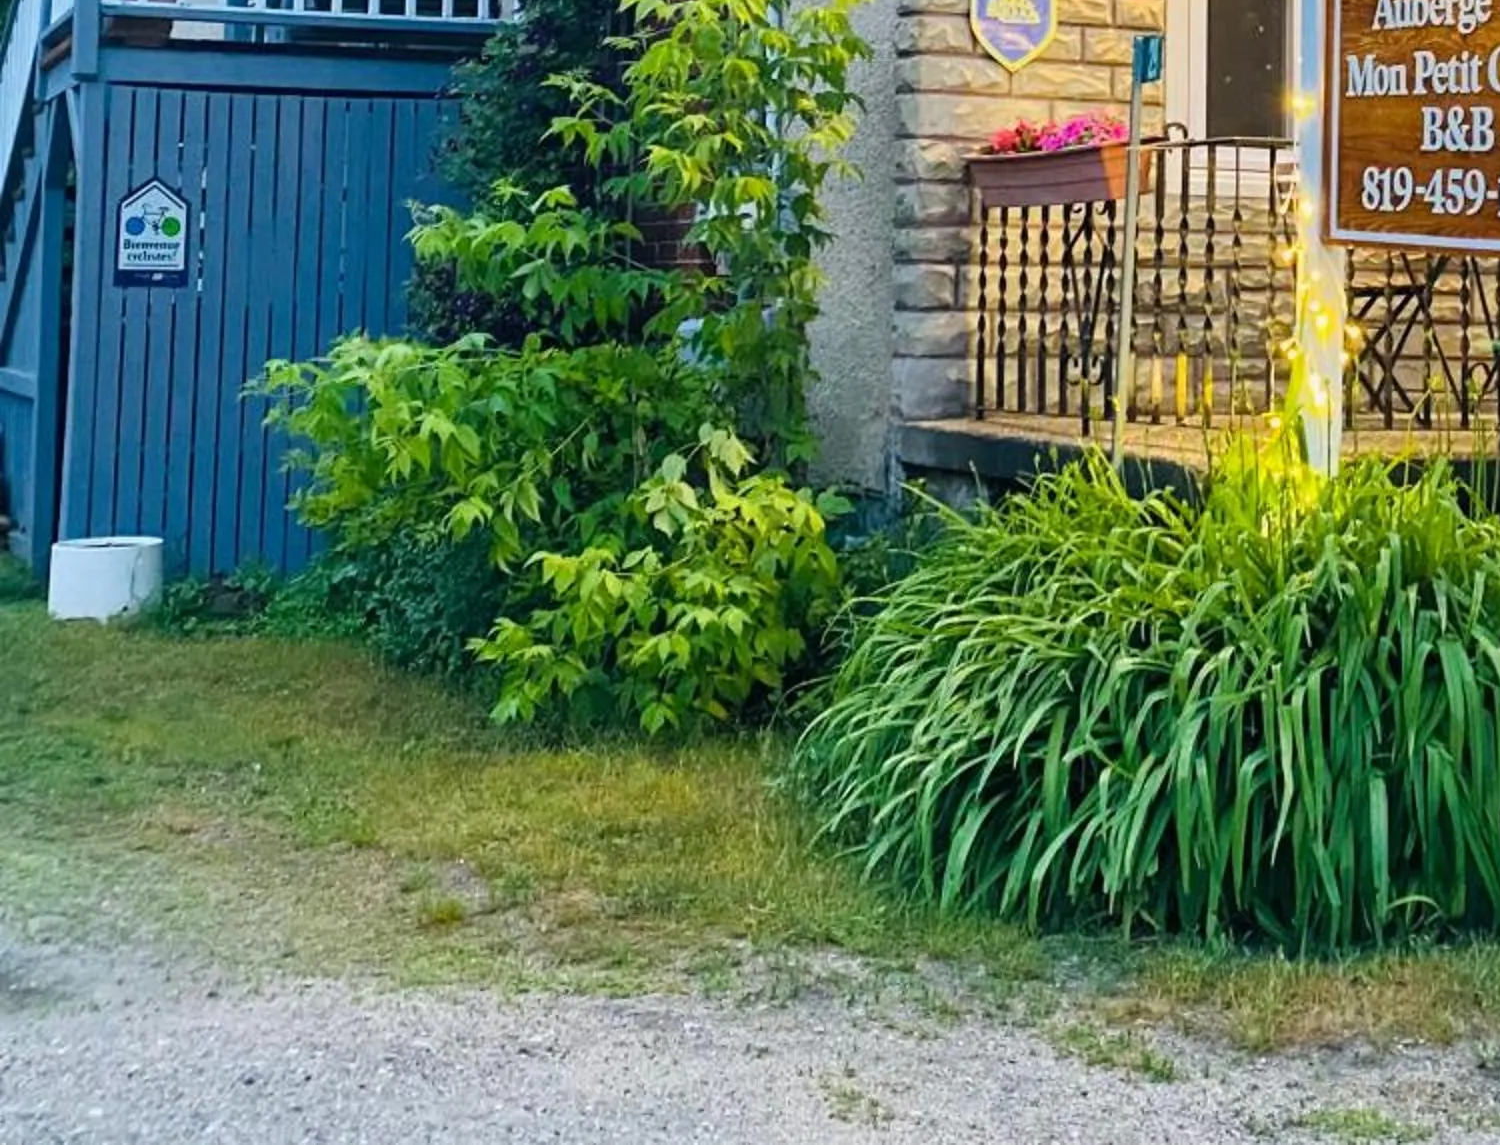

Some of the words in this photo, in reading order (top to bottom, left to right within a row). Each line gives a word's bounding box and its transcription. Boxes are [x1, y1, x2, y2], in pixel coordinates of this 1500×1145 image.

[1346, 54, 1409, 98] Mon
[1413, 50, 1483, 96] Petit
[1420, 104, 1496, 153] B&B
